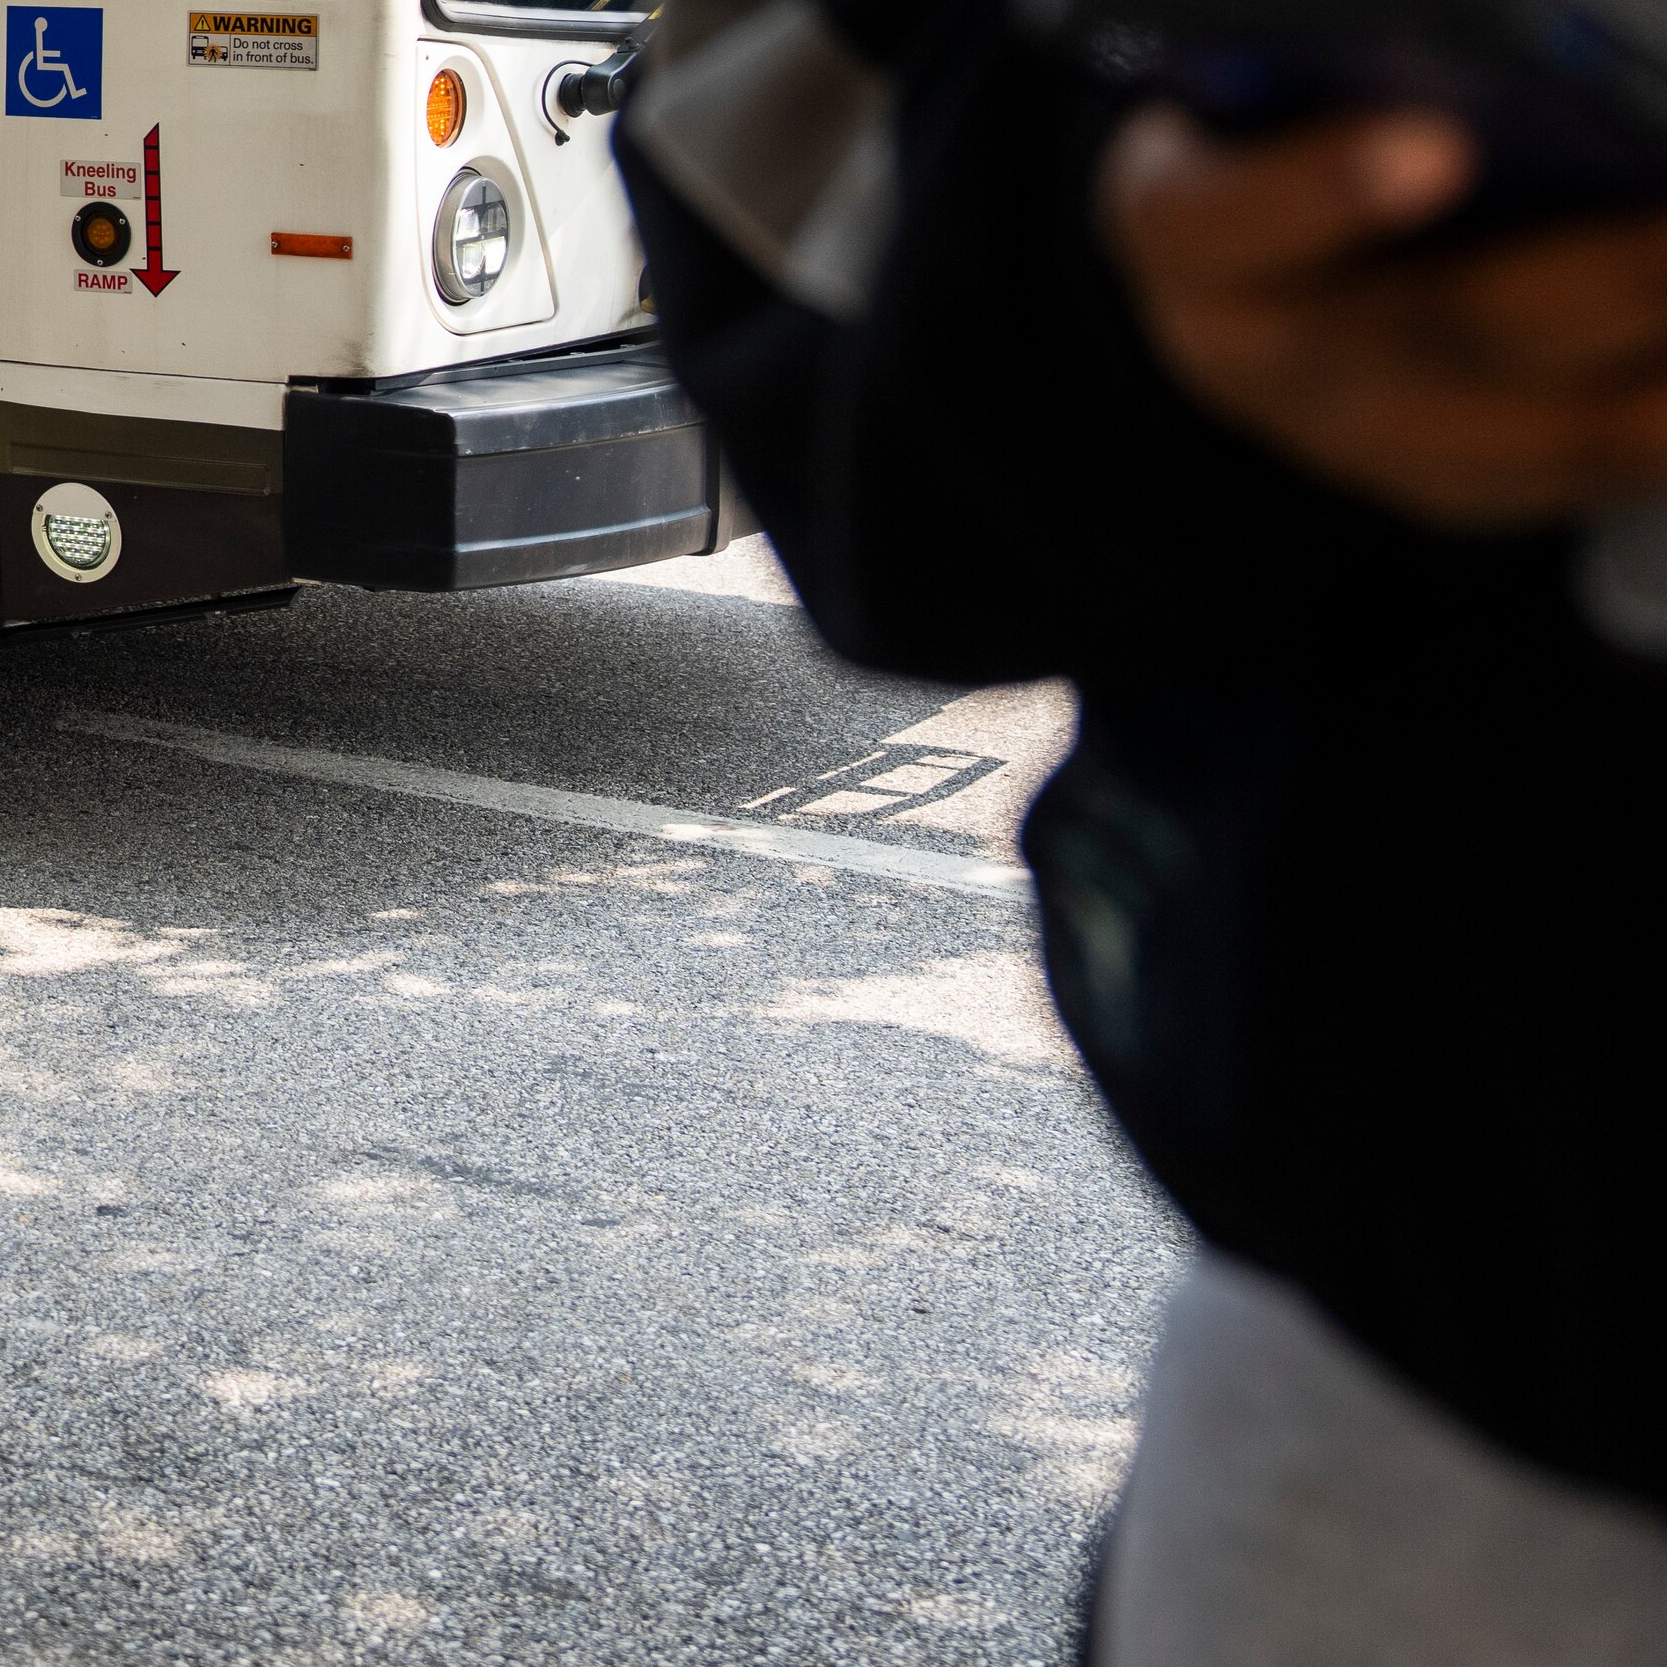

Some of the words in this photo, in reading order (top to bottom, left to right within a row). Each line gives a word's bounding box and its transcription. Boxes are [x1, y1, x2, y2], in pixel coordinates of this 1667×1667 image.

[213, 16, 312, 34] WARNING
[233, 38, 249, 49] Do
[252, 39, 271, 50] not
[273, 41, 303, 51] cross
[233, 51, 243, 62] in
[246, 51, 273, 63] front
[275, 52, 288, 64] of
[290, 53, 314, 65] bus.
[64, 161, 137, 183] Kneeling
[84, 181, 116, 197] Bus
[78, 273, 128, 290] RAMP
